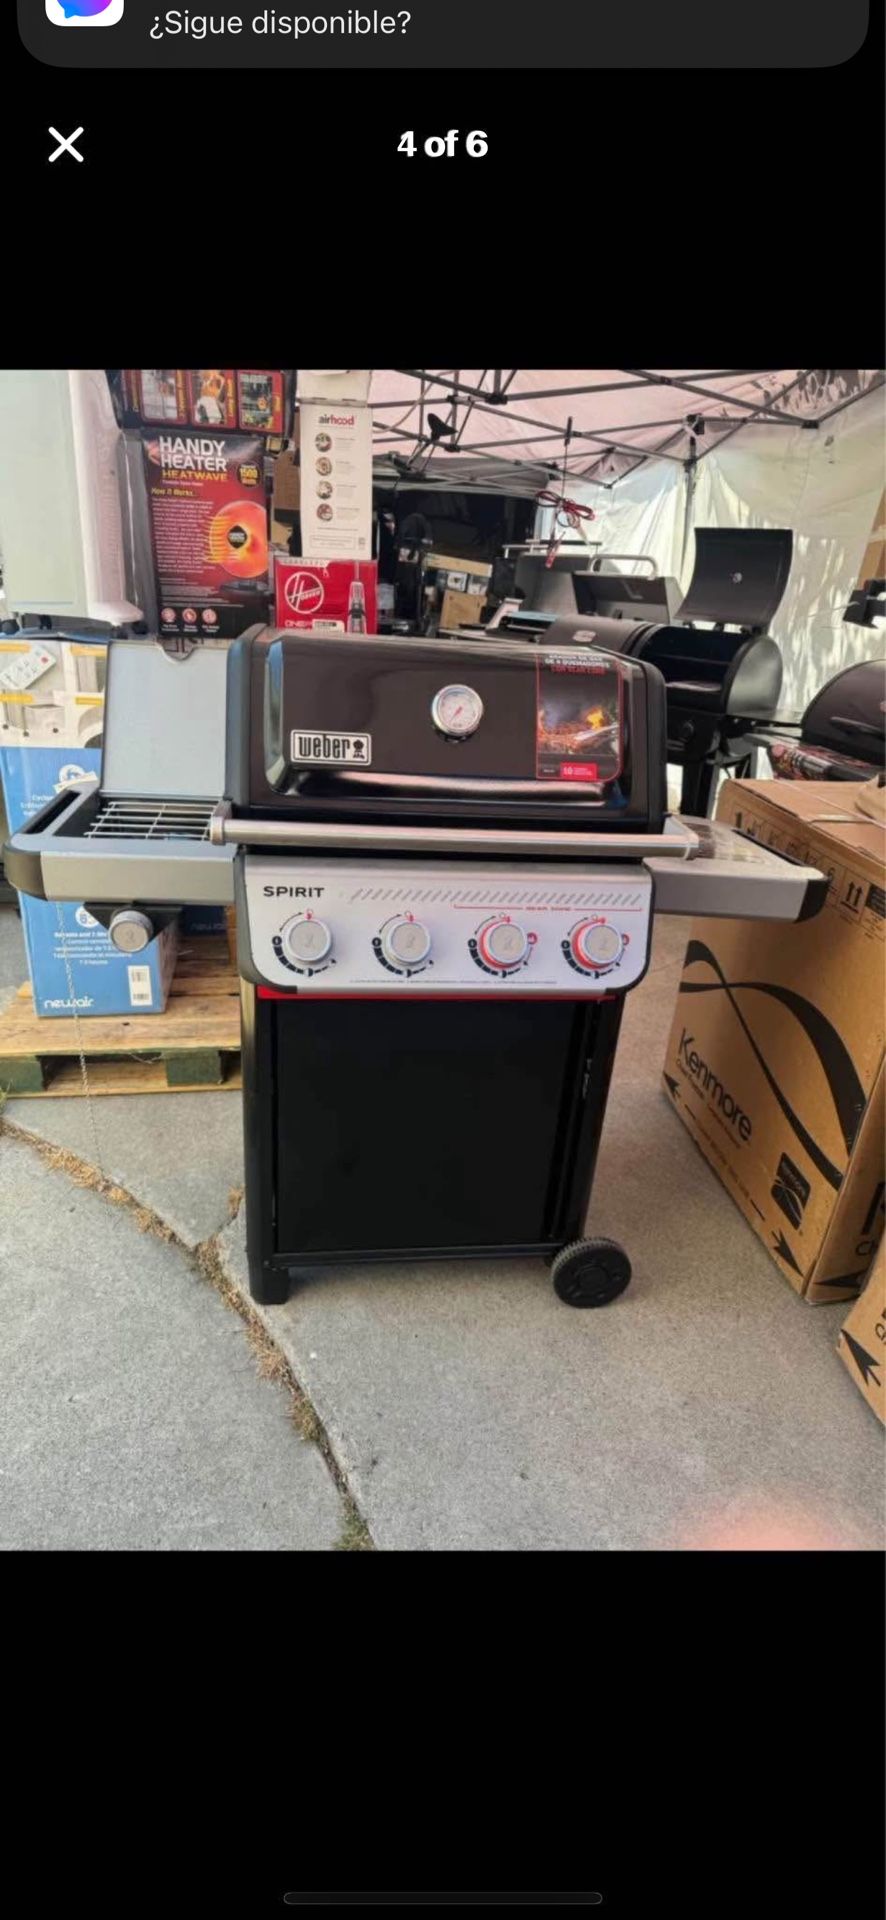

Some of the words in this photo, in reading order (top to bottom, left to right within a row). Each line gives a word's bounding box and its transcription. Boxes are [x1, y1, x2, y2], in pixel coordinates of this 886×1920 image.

[319, 414, 355, 425] airhood
[160, 436, 226, 457] HANDY
[161, 453, 227, 472] HEATER
[162, 469, 228, 482] HEATWAVE
[298, 734, 350, 759] weber
[263, 886, 325, 898] SPIRIT
[678, 1027, 752, 1142] Kenmore
